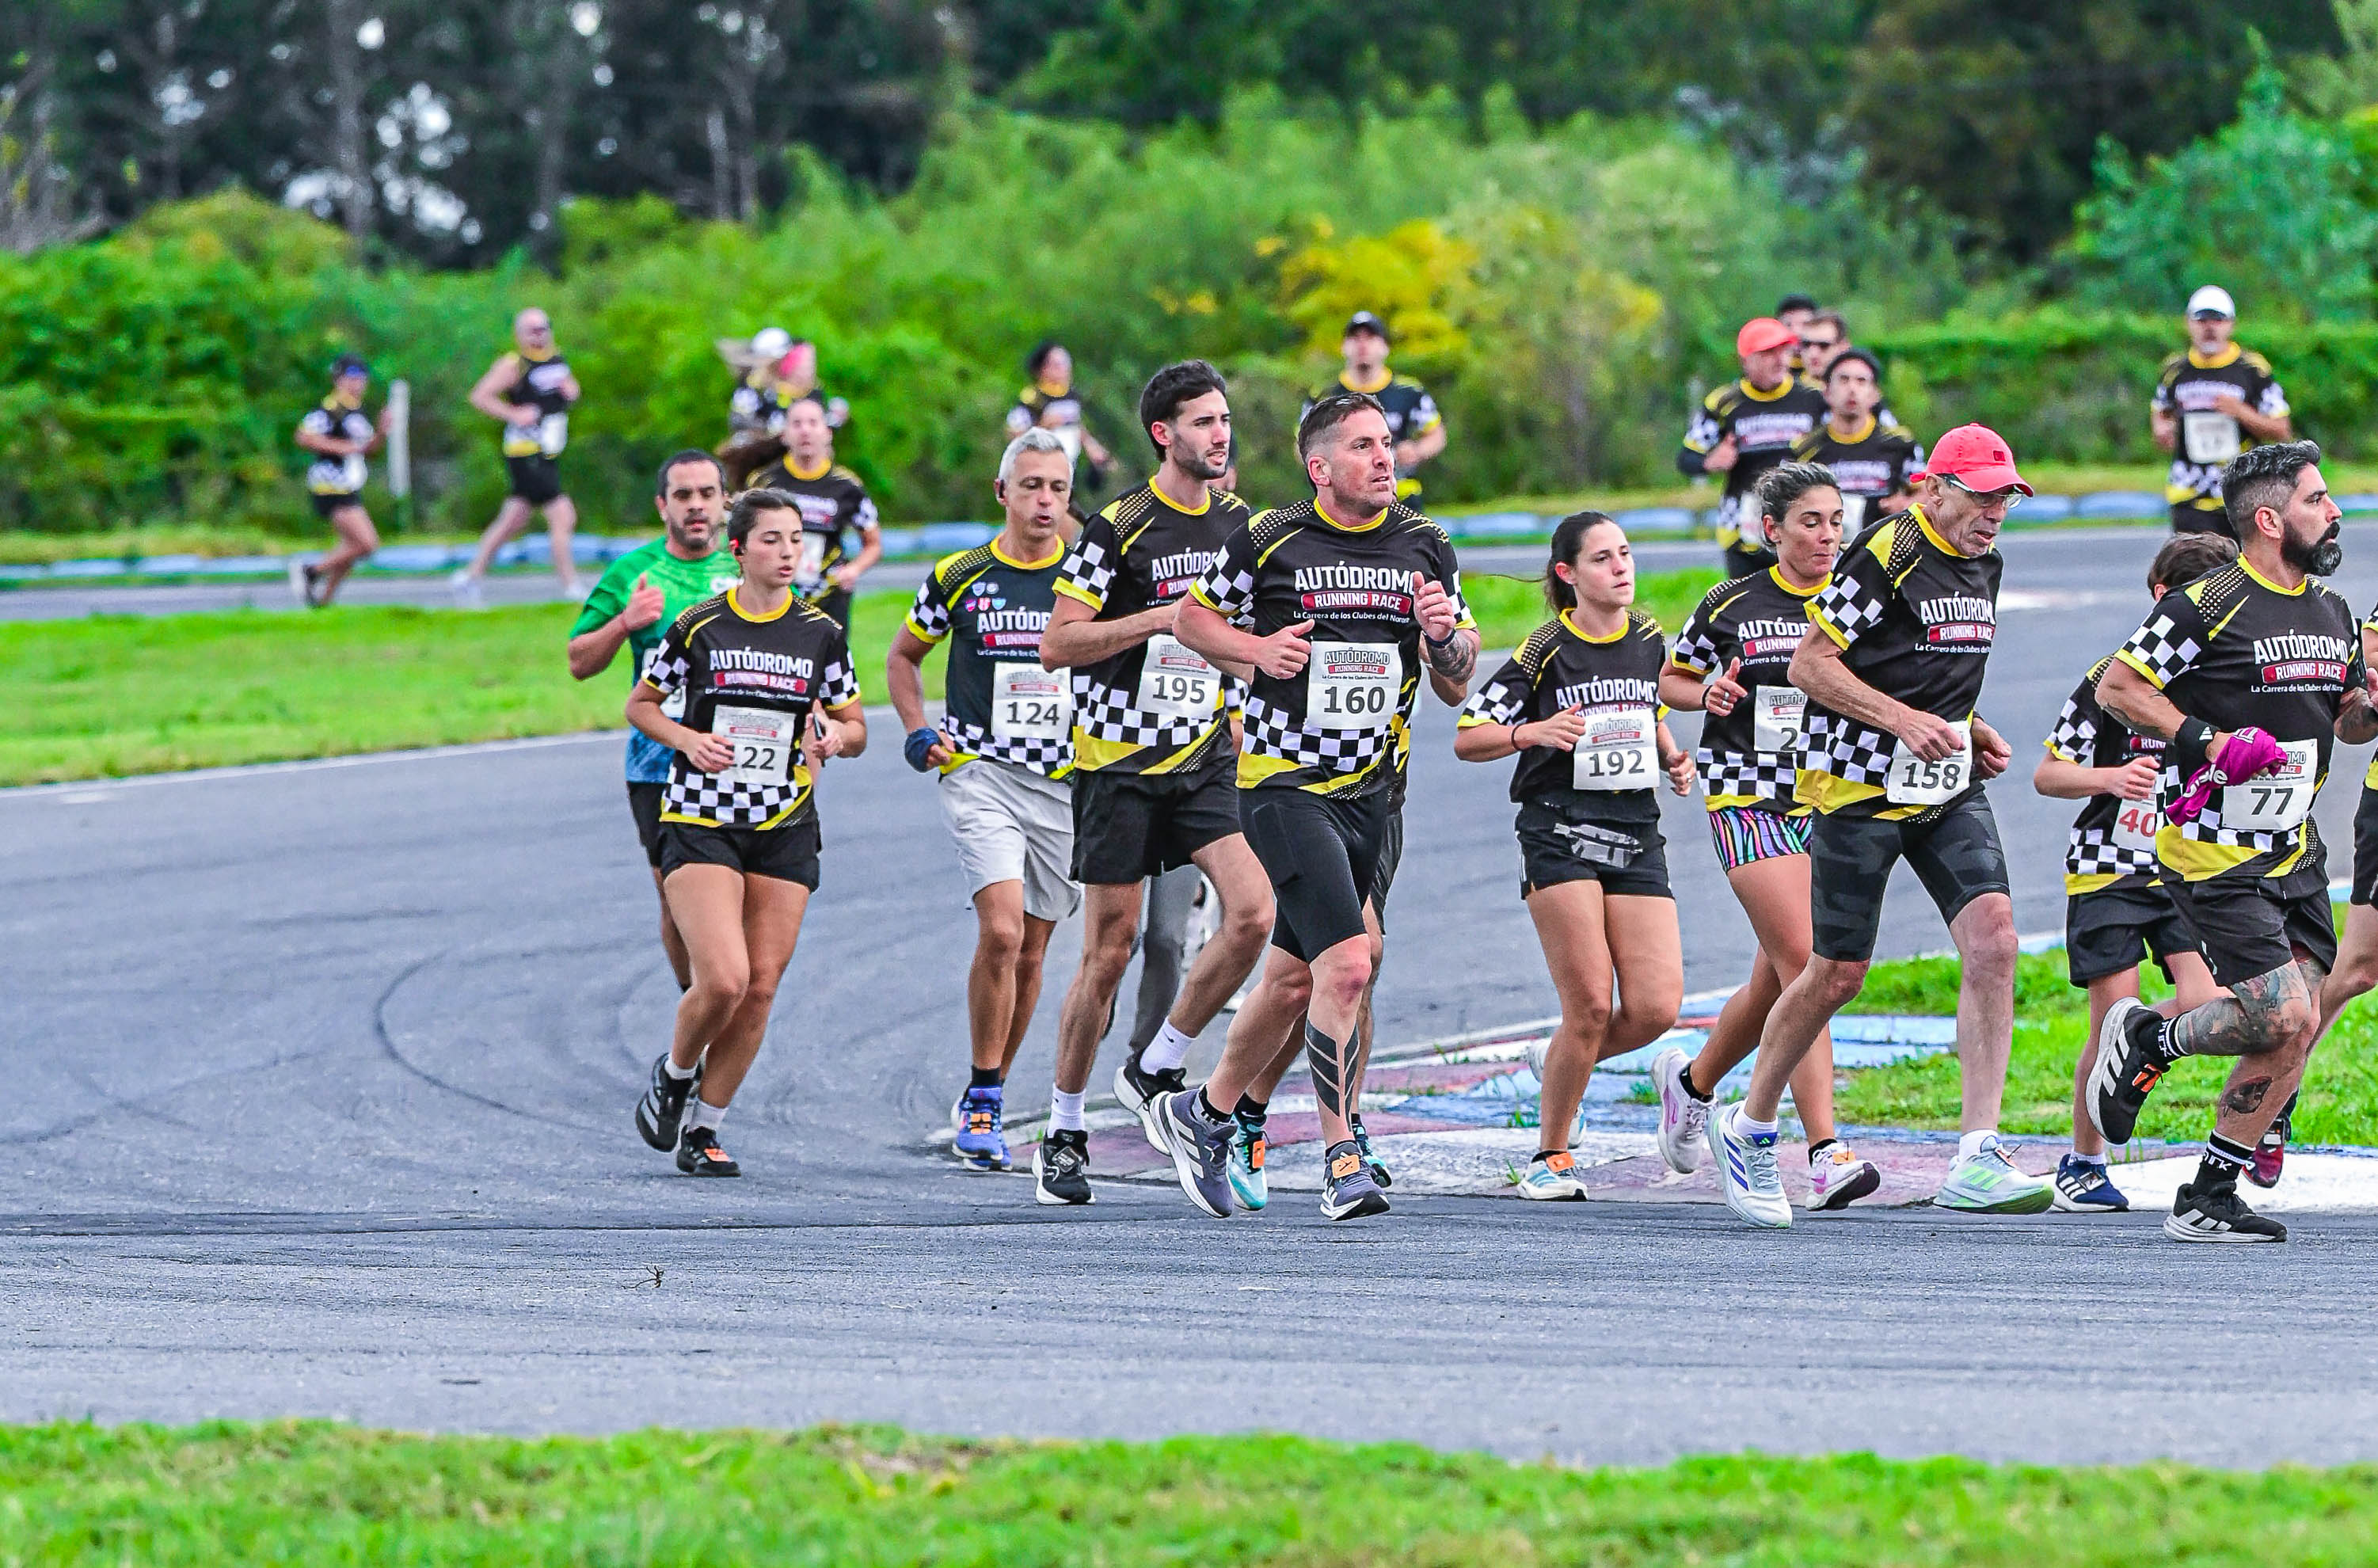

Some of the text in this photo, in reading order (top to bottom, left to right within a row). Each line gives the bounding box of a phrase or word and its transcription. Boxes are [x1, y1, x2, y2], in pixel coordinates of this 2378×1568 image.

[1151, 547, 1219, 581] AUTÓDR
[1315, 593, 1402, 611] RUNNING RACE
[1920, 592, 1996, 626] AUTÓDROM
[1915, 642, 1924, 651] La
[1940, 625, 1977, 641] RUNNING
[2253, 629, 2349, 665] AUTÓDROMO
[710, 645, 813, 679] AUTÓDROMO
[1324, 646, 1391, 664] AUTÓDROMO
[2275, 663, 2342, 680] RUNNING RACE
[1153, 676, 1205, 704] 195
[1324, 687, 1385, 714] 160
[1006, 702, 1060, 726] 124
[732, 746, 775, 770] 22
[1589, 750, 1646, 778] 192
[1902, 762, 1961, 790] 158
[2251, 788, 2294, 816] 77
[2118, 809, 2155, 838] 40
